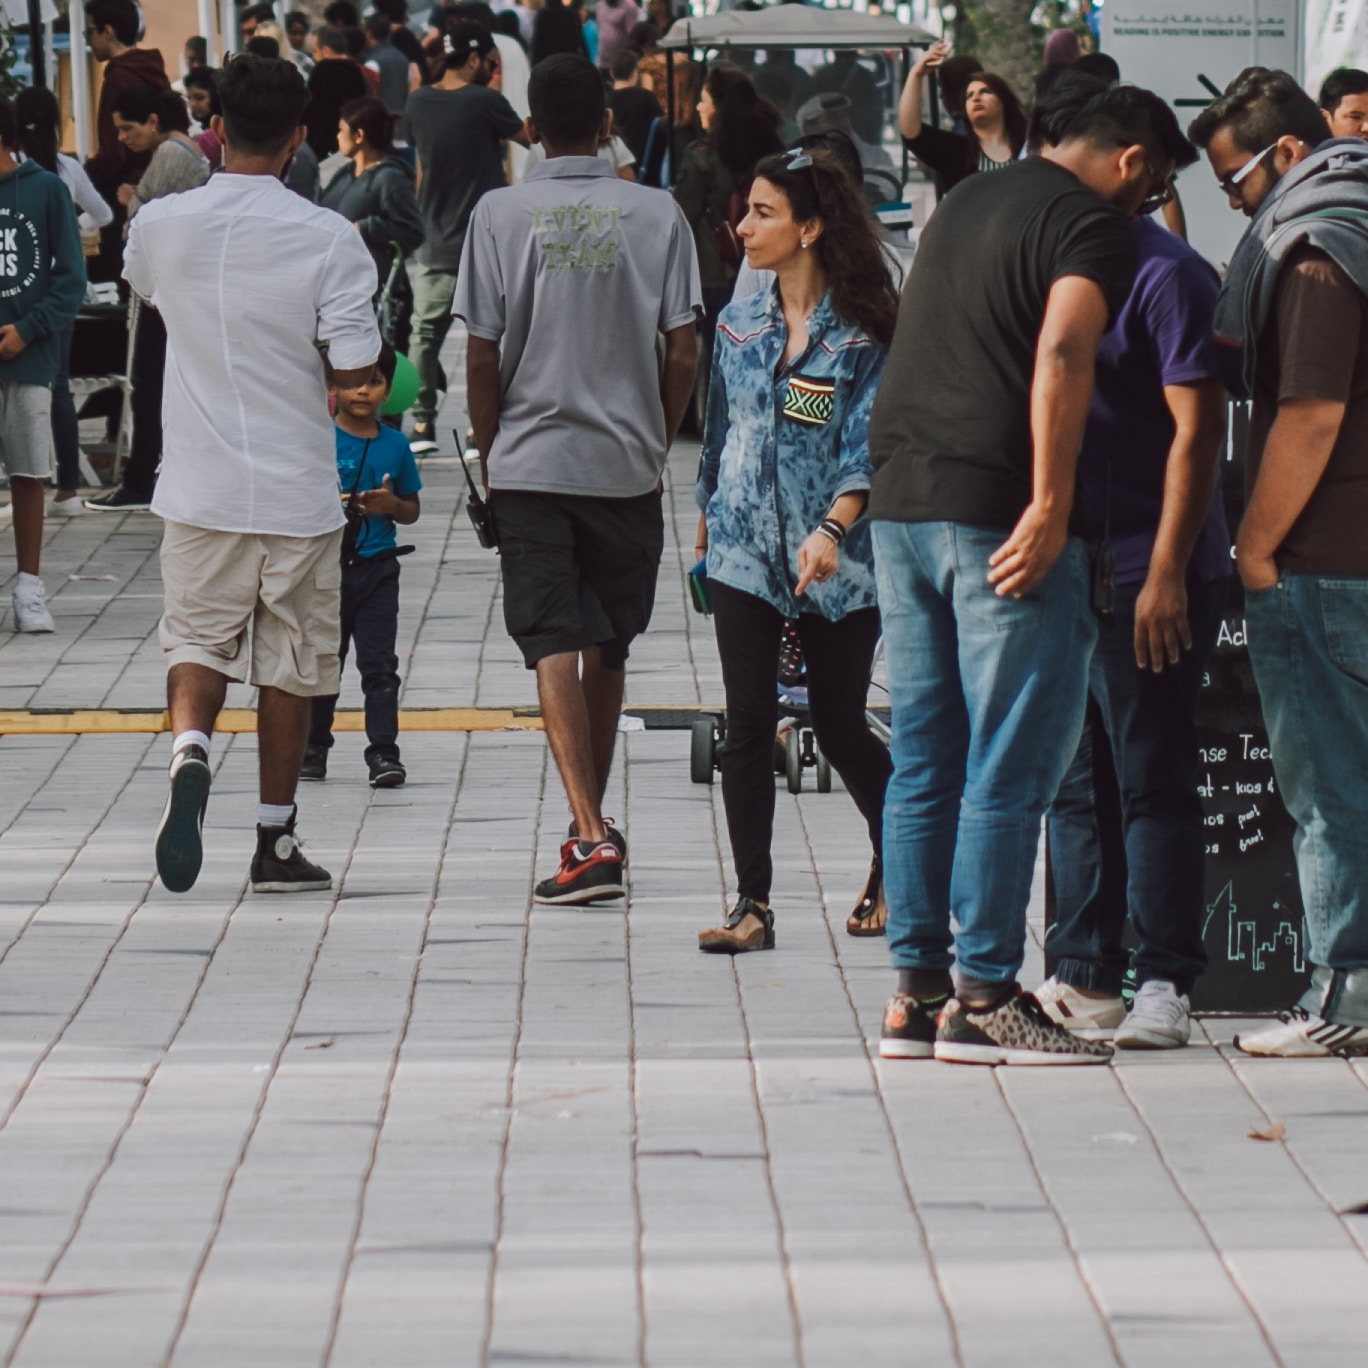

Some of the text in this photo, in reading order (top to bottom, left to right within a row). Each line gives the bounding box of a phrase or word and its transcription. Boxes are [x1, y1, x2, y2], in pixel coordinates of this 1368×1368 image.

[1113, 28, 1150, 37] READING
[1161, 28, 1200, 37] POSITIVE
[1202, 28, 1233, 37] ENERGY
[534, 206, 621, 233] EVENT
[541, 241, 617, 270] TEAM
[1239, 734, 1272, 760] Tec
